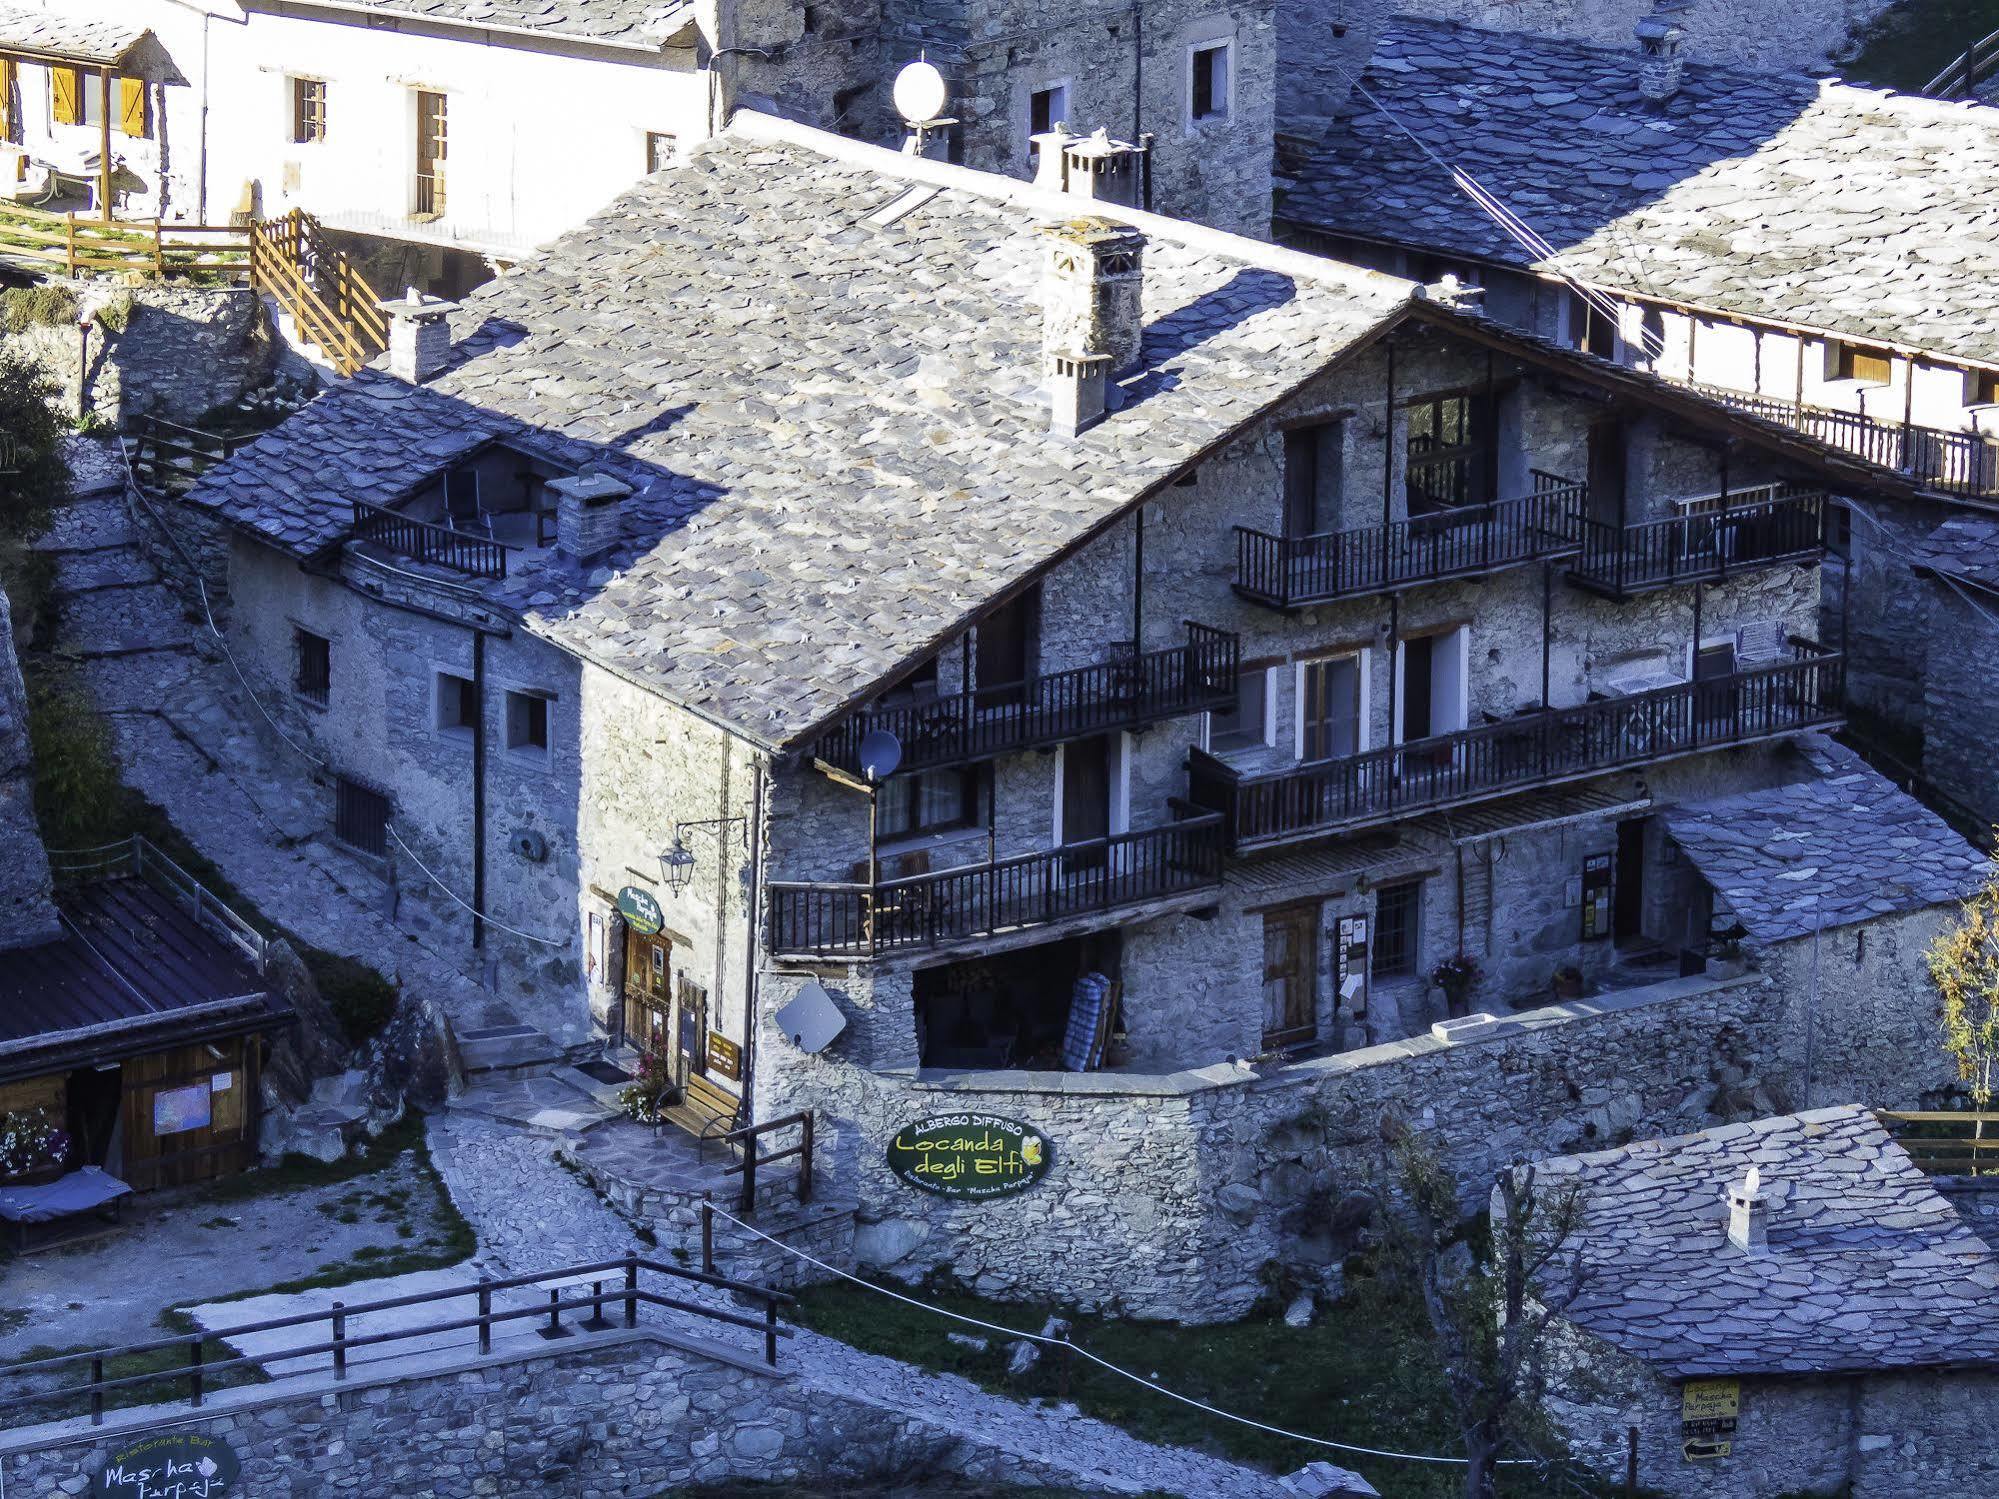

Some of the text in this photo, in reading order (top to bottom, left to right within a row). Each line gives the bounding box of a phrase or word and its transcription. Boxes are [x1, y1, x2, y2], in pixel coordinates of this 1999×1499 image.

[915, 1116, 1023, 1136] ALBERGO DIFFUSO
[896, 1131, 1004, 1152] Locanda
[914, 1150, 1023, 1180] degli Elfi
[190, 1435, 214, 1448] Bar
